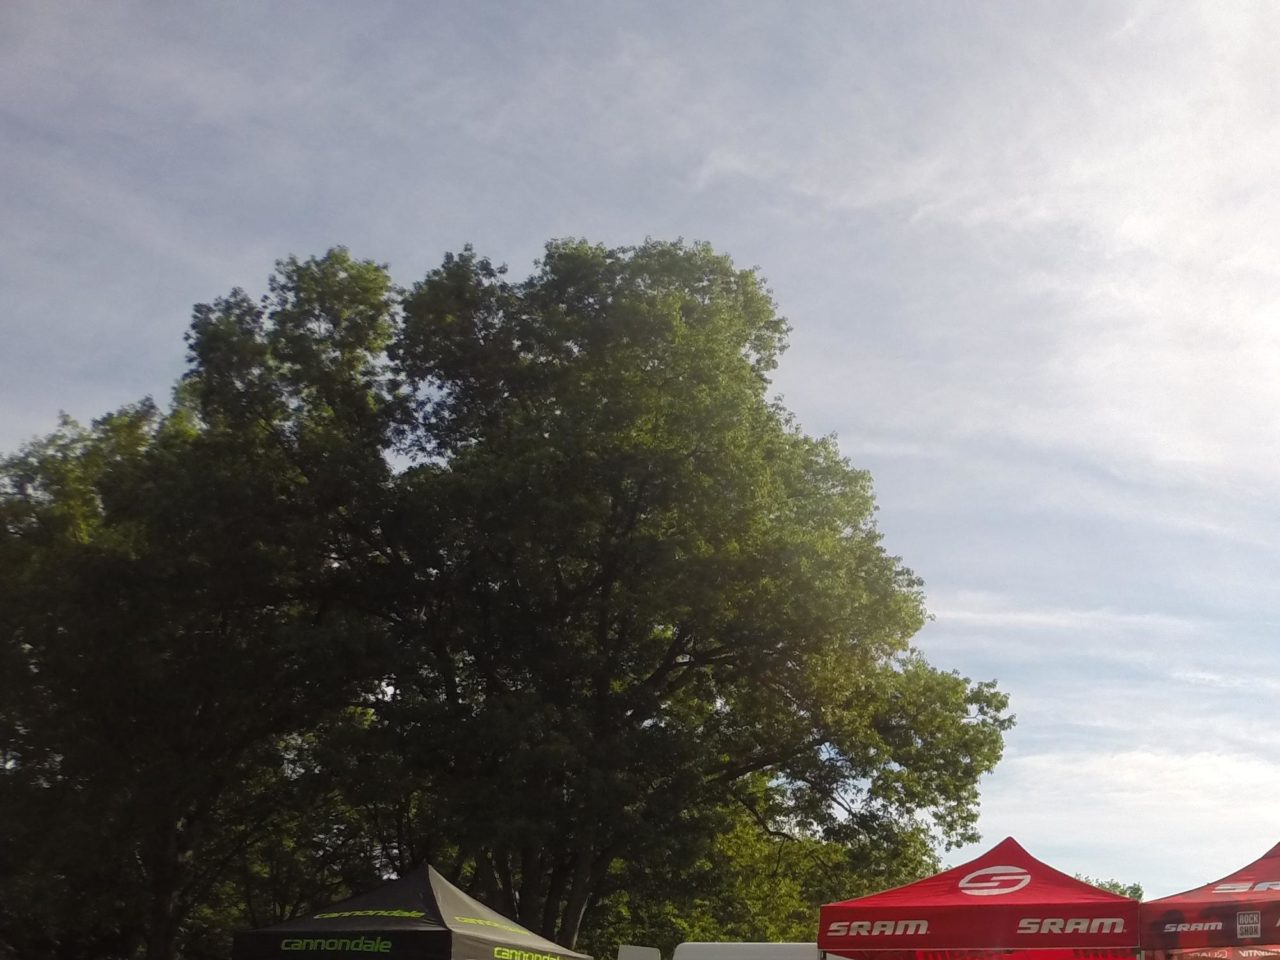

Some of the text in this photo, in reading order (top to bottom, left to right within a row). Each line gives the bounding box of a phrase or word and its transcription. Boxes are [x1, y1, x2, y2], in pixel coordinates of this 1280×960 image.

[827, 920, 930, 936] SRAM
[1016, 918, 1126, 934] SRAM
[1163, 922, 1222, 932] SRAM
[280, 936, 393, 953] cannondale
